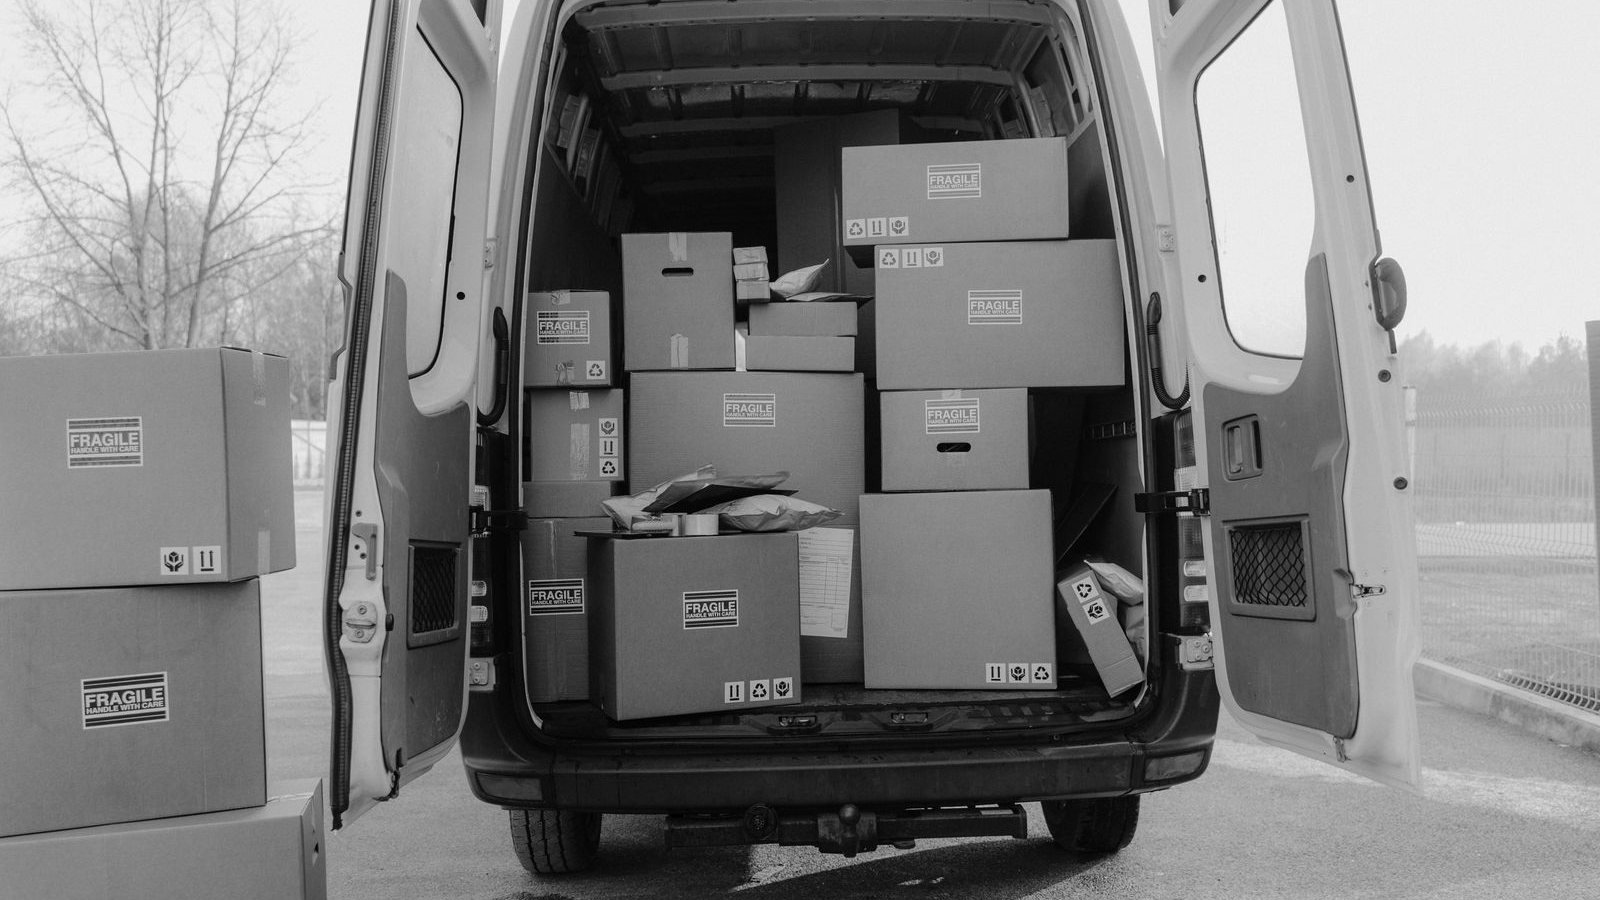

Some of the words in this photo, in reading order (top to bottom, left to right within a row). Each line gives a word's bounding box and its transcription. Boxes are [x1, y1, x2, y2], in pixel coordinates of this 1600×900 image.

[930, 174, 977, 185] FRAGILE
[970, 301, 1019, 310] FRAGILE
[539, 320, 586, 330] FRAGILE
[726, 404, 772, 413] FRAGILE
[928, 409, 976, 419] FRAGILE
[71, 432, 138, 447] FRAGILE
[532, 590, 580, 601] FRAGILE
[686, 602, 735, 614] FRAGILE
[86, 687, 162, 707] FRAGILE
[86, 704, 118, 714] HANDLE
[121, 702, 140, 711] WITH
[142, 700, 164, 708] CARE
